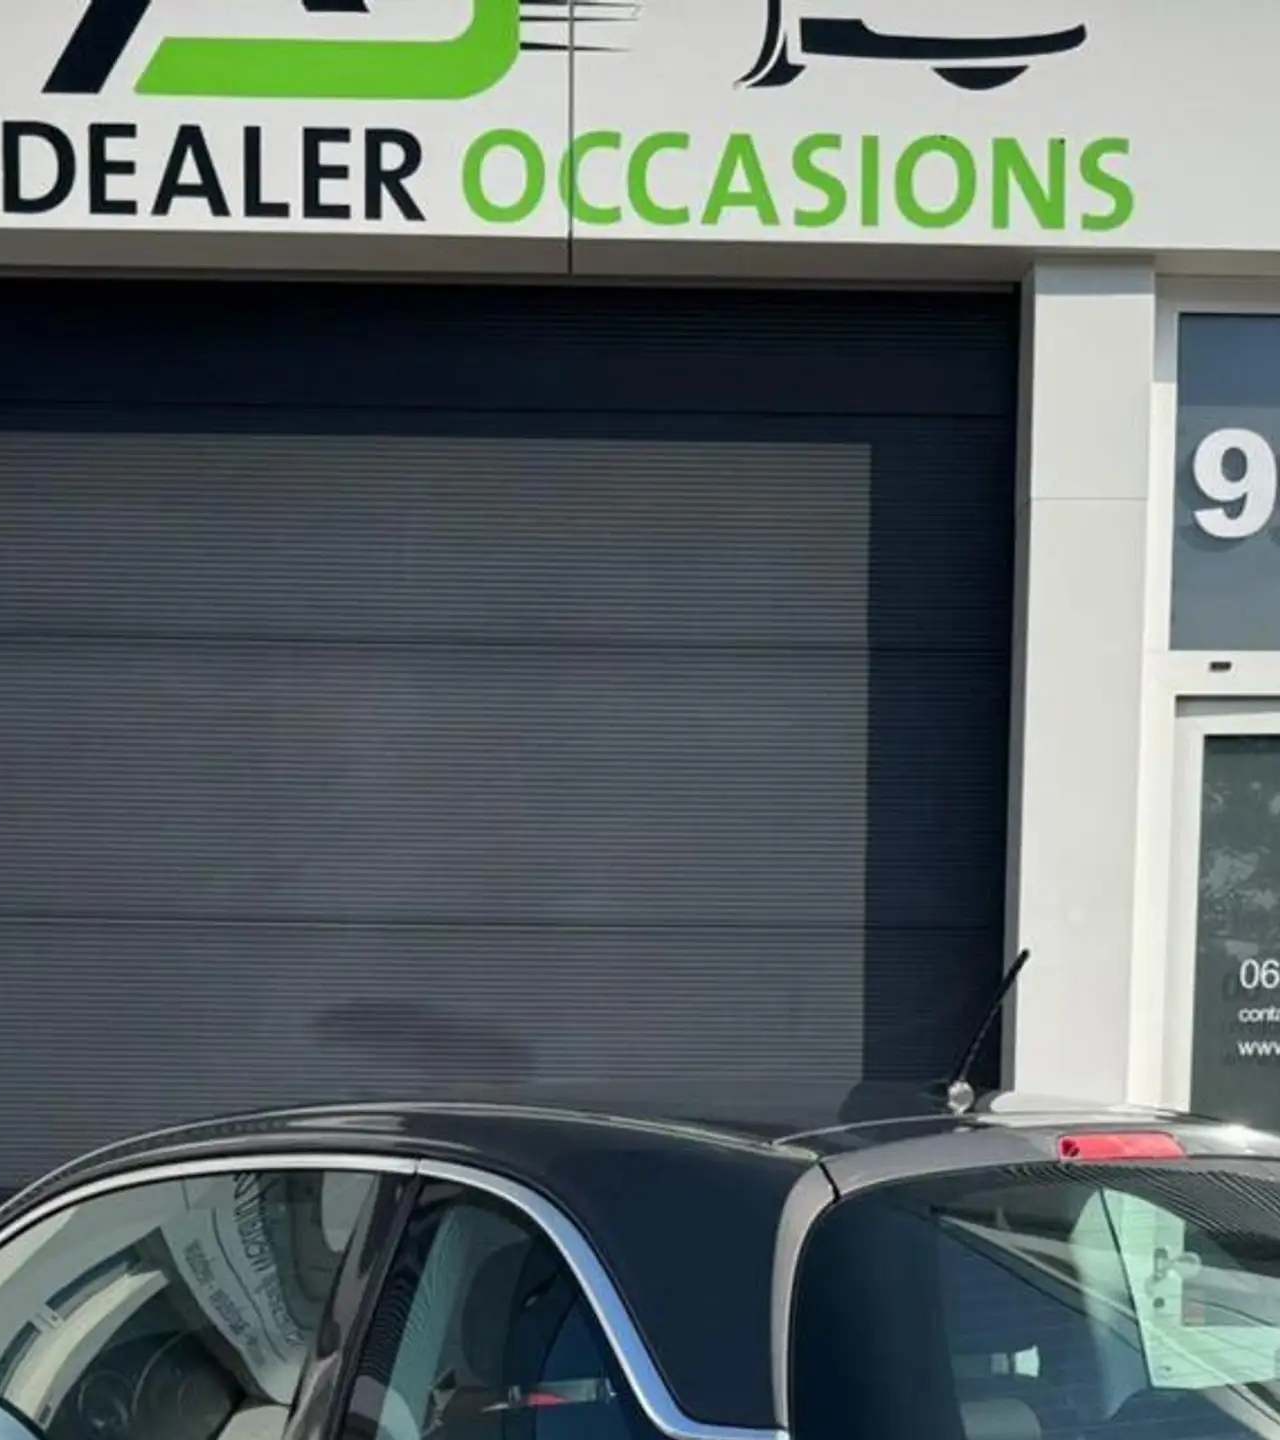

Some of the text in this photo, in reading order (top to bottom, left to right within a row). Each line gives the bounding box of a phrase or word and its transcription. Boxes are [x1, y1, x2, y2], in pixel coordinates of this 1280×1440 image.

[1, 120, 1136, 232] DEALER OCCASIONS
[1238, 957, 1280, 989] 06
